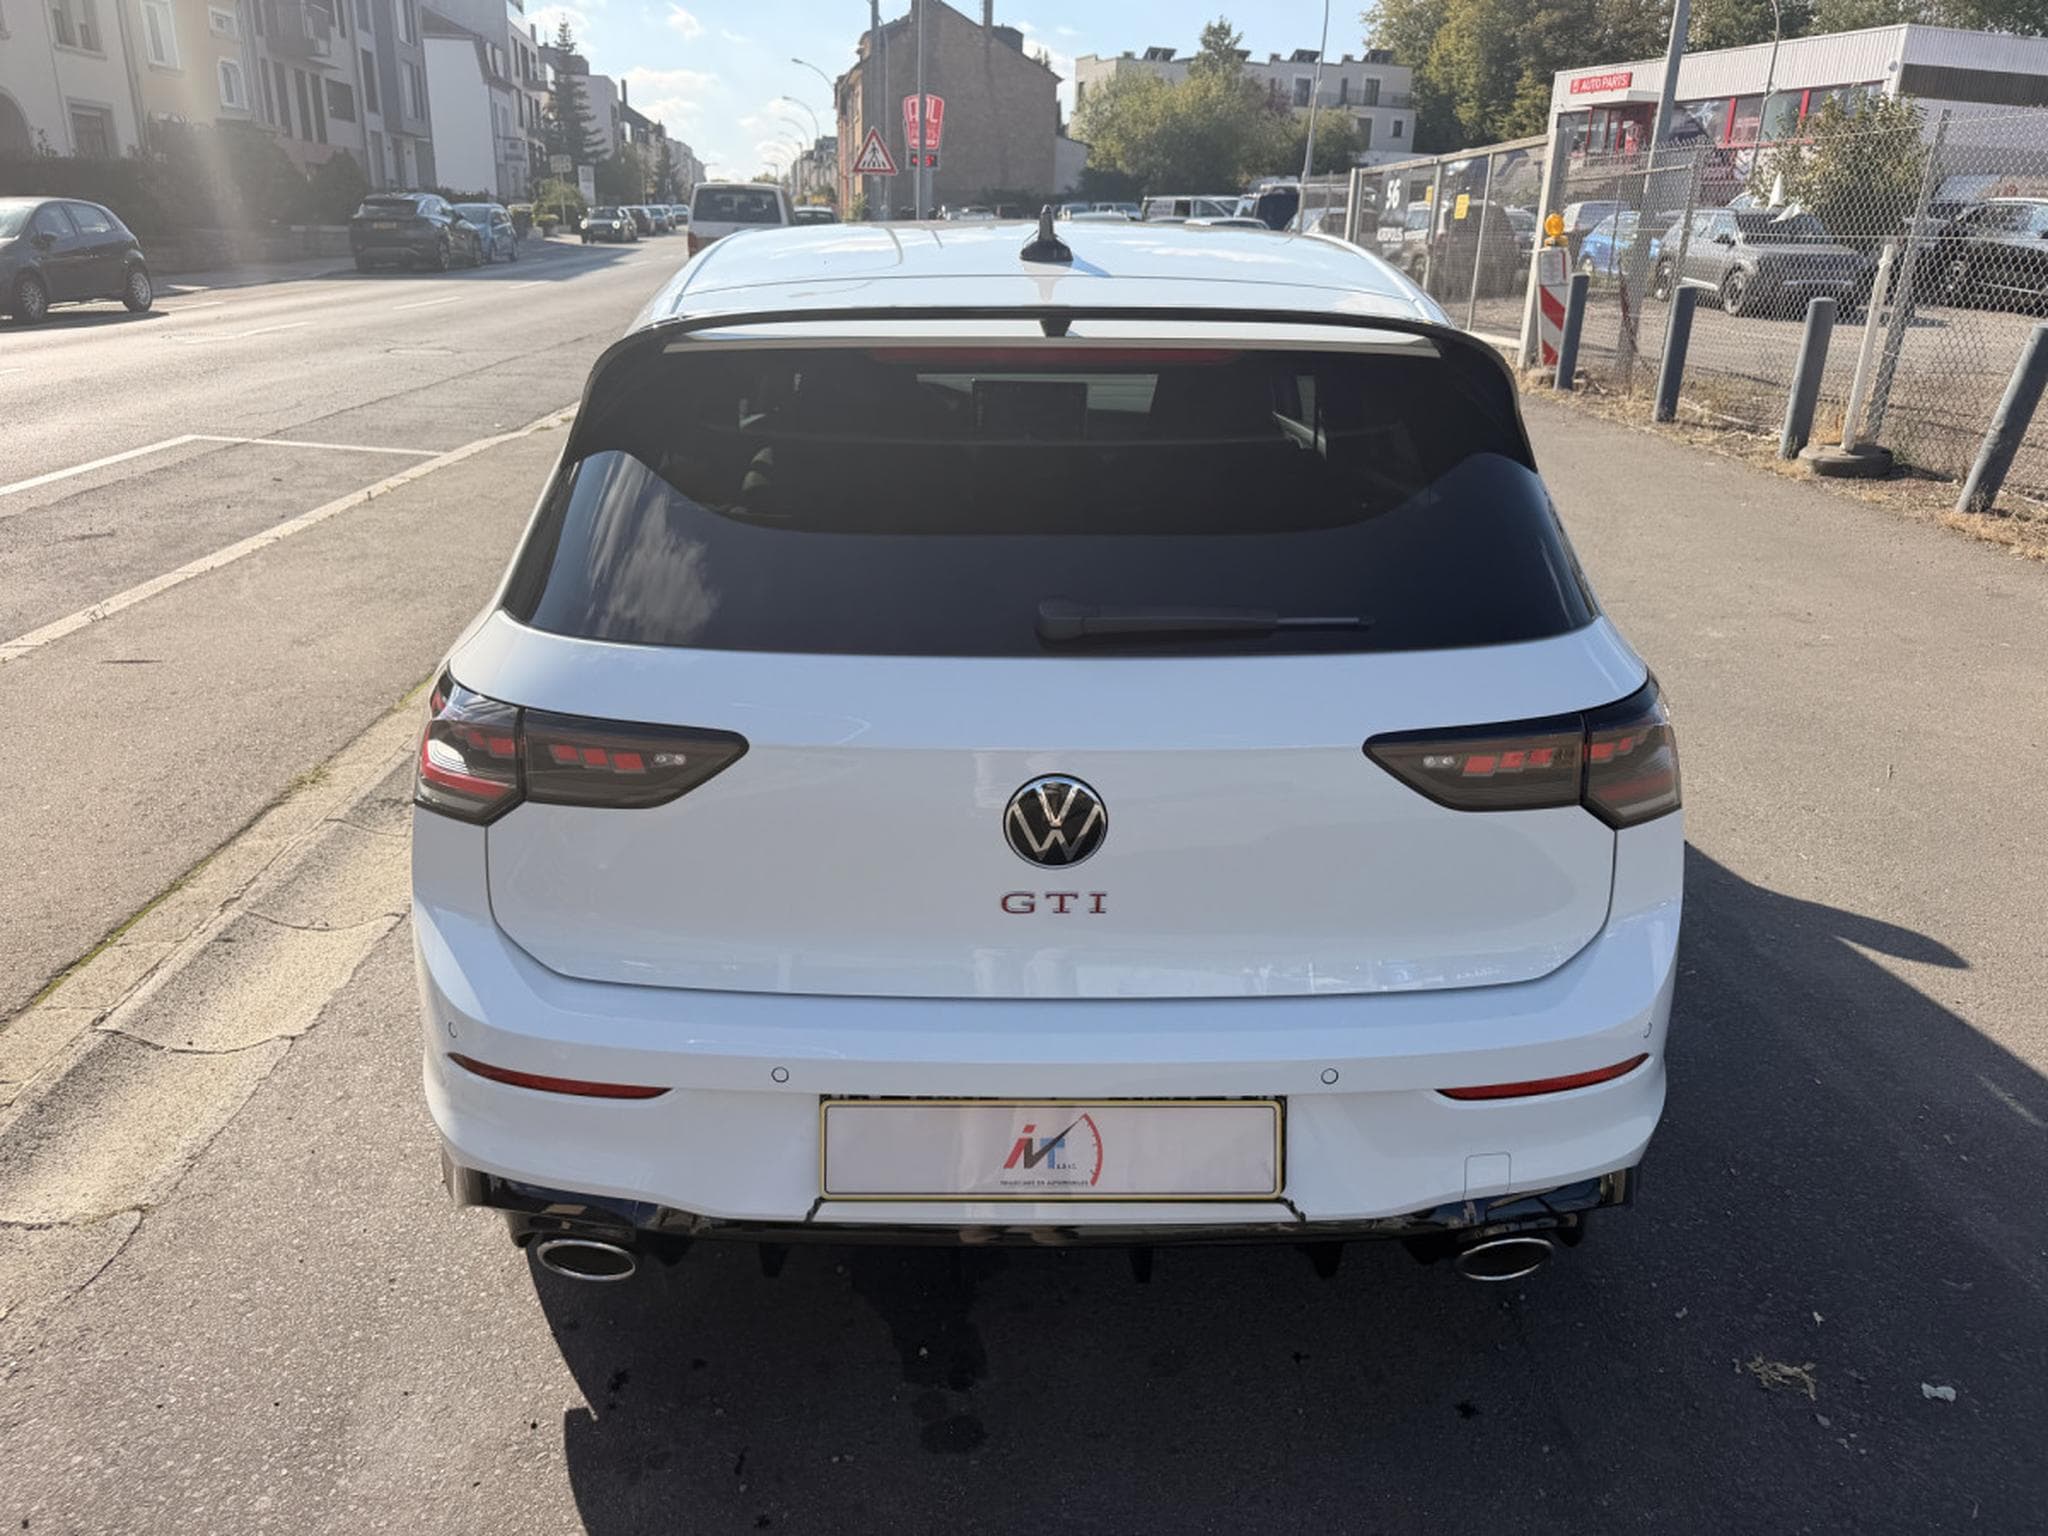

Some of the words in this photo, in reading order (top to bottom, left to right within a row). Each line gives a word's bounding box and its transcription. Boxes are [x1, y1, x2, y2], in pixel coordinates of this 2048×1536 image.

[1581, 77, 1602, 92] AUTO
[1602, 73, 1629, 89] PARTS
[1000, 891, 1108, 915] GTI
